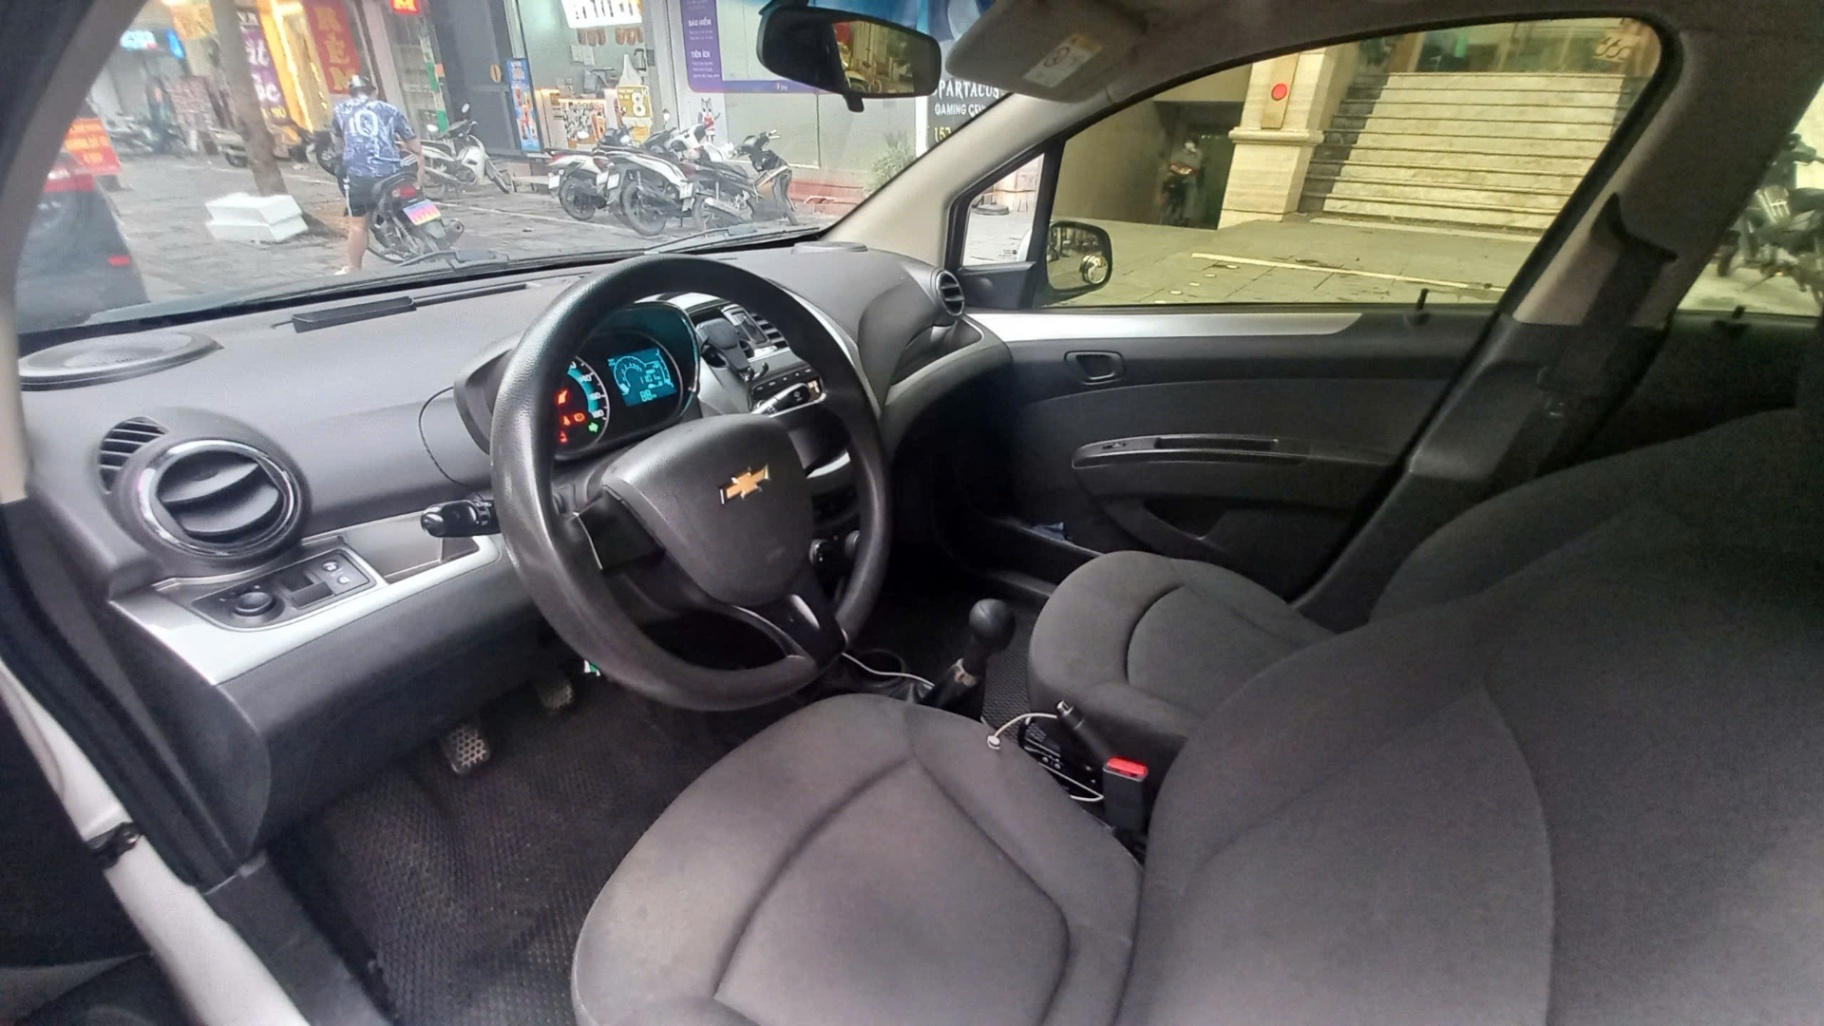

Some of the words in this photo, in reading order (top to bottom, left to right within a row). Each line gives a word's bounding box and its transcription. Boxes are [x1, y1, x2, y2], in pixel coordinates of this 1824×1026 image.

[931, 79, 1000, 100] PARTACUS
[934, 102, 967, 116] GAMING
[349, 109, 379, 138] 10
